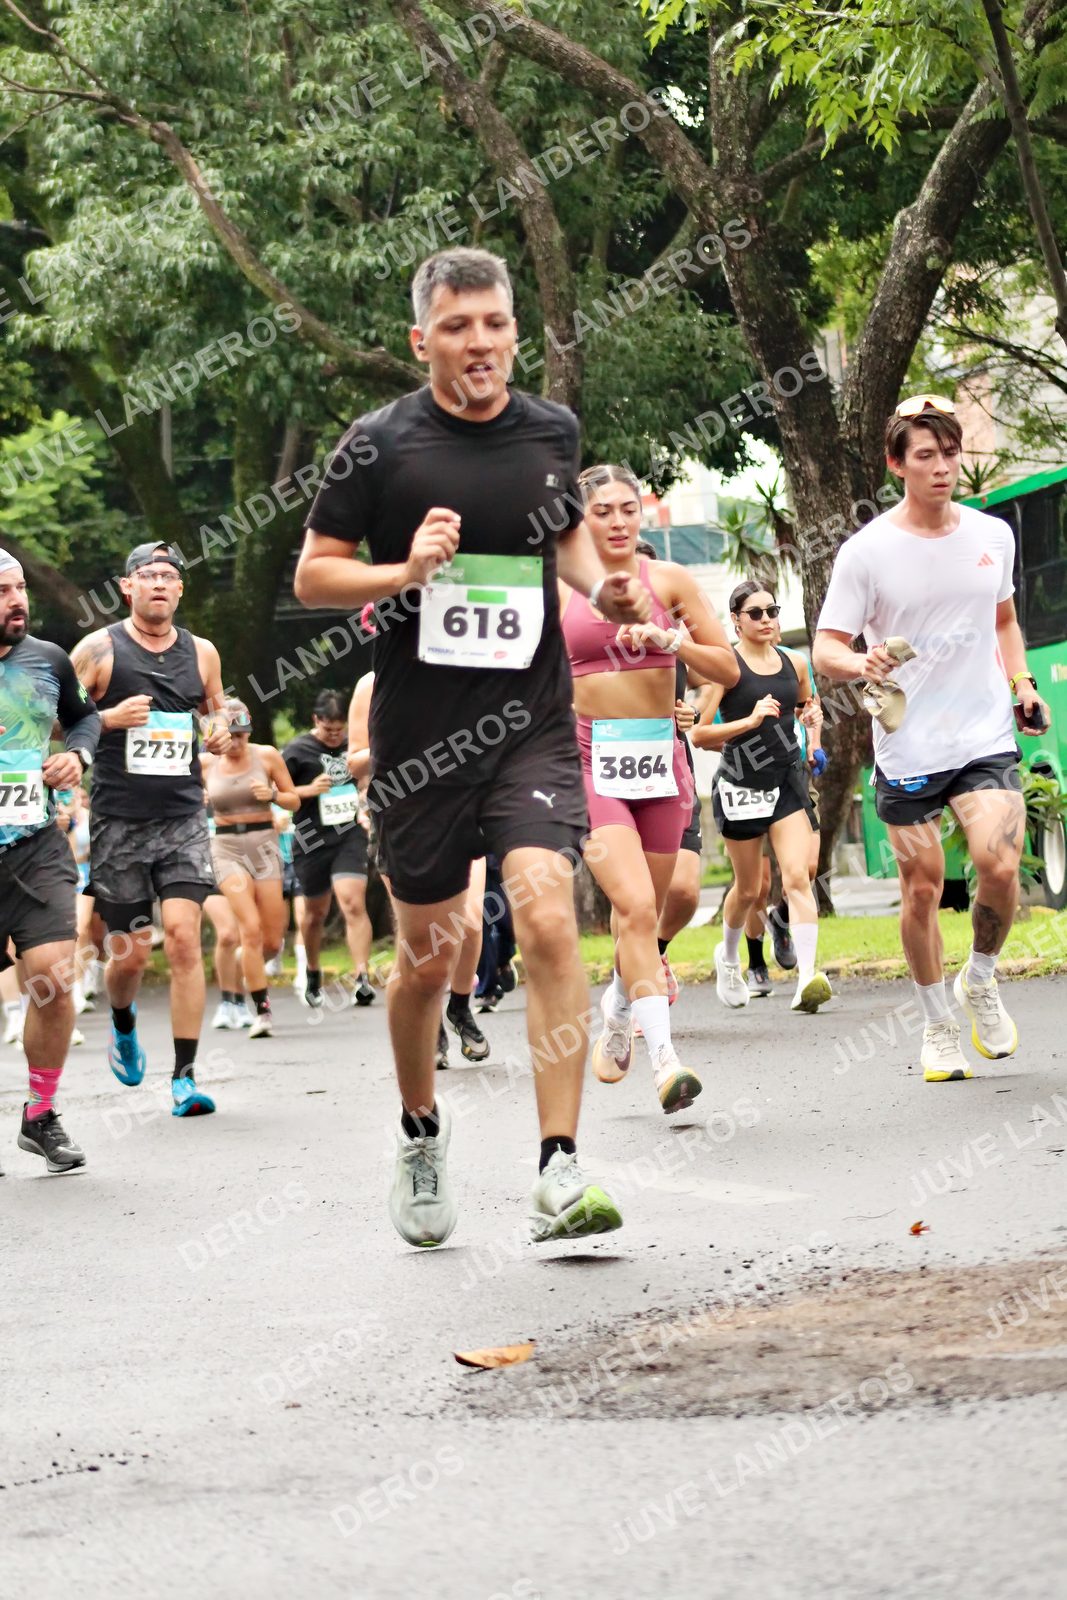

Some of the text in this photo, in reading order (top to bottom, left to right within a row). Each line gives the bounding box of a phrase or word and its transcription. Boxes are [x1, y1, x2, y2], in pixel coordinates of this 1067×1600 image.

[443, 606, 522, 640] 618
[132, 739, 190, 760] 2737
[600, 755, 668, 780] 3864
[725, 790, 776, 808] 1256
